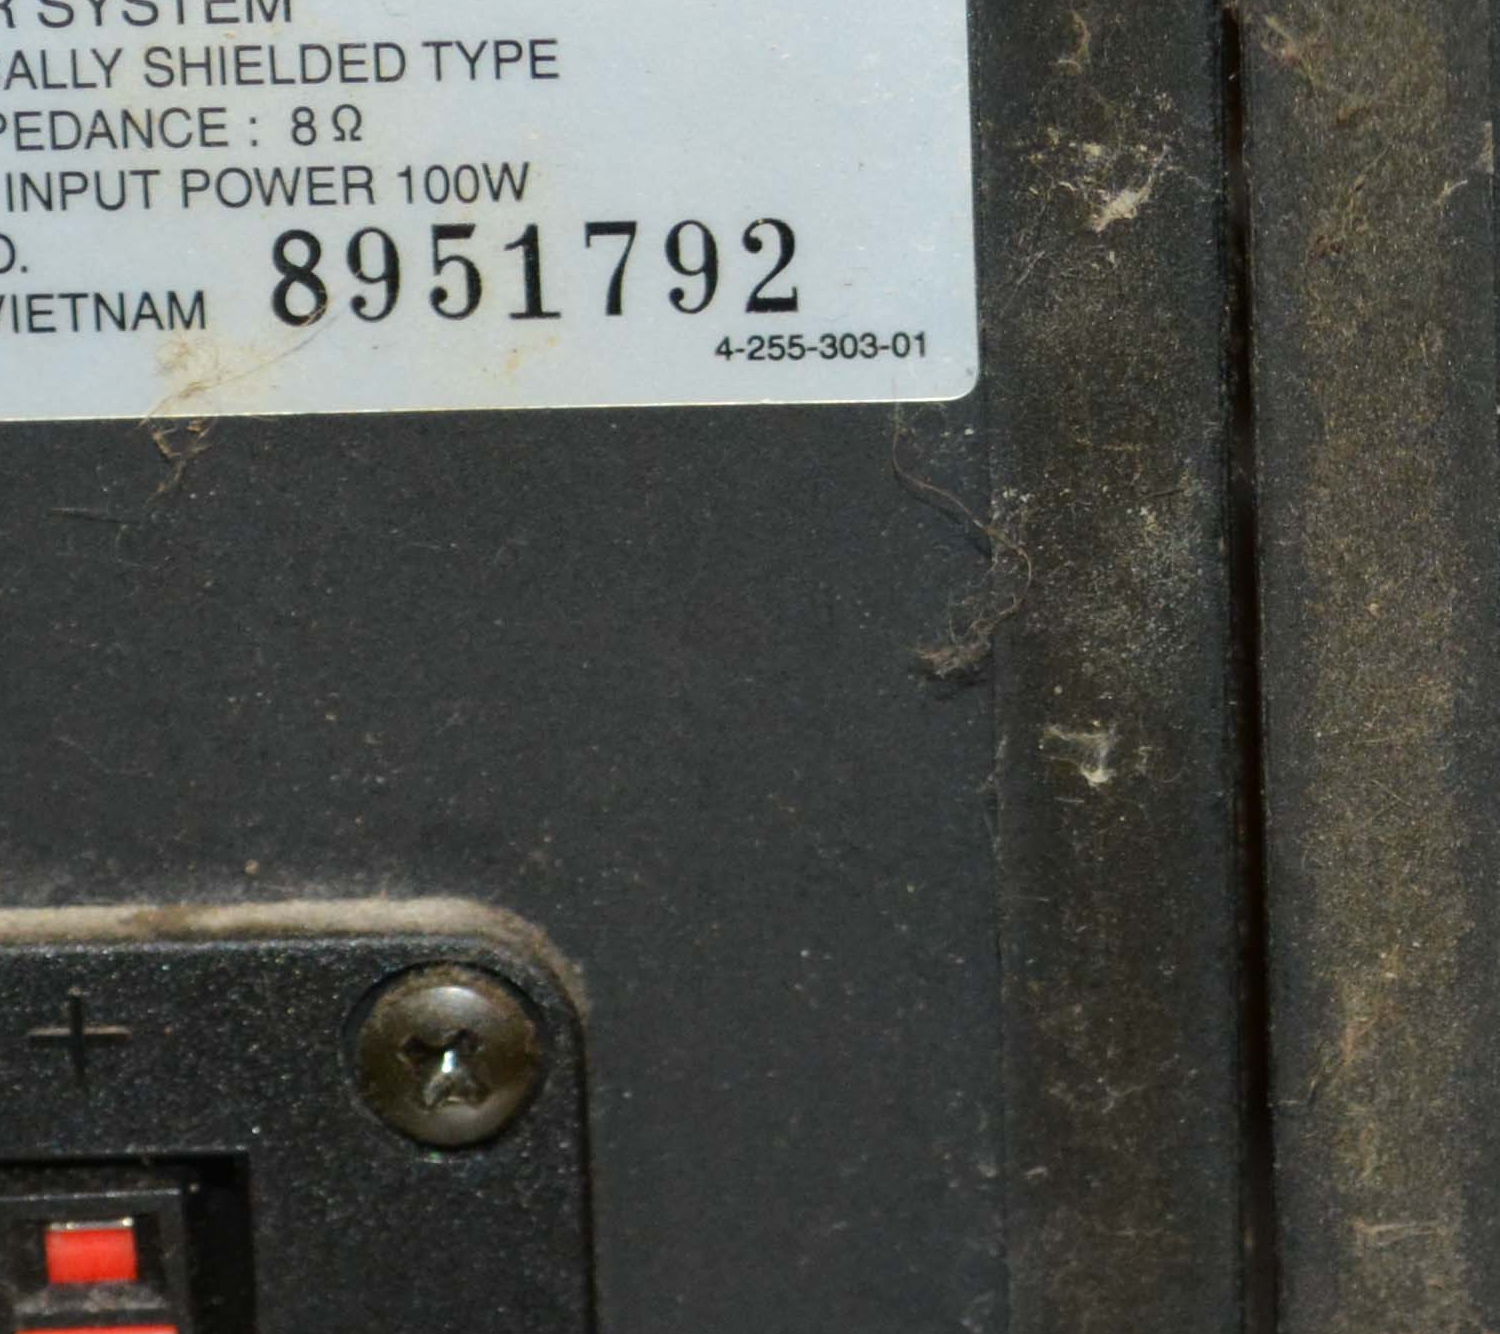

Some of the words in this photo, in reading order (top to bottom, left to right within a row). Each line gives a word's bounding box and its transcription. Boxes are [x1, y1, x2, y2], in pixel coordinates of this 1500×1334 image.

[143, 41, 407, 89] SHIELDED
[421, 38, 560, 82] TYPE
[5, 169, 161, 213] INPUT
[181, 165, 376, 209] POWER
[397, 161, 530, 205] 100W
[271, 217, 799, 327] 8951792
[714, 331, 926, 362] 4-255-303-01
